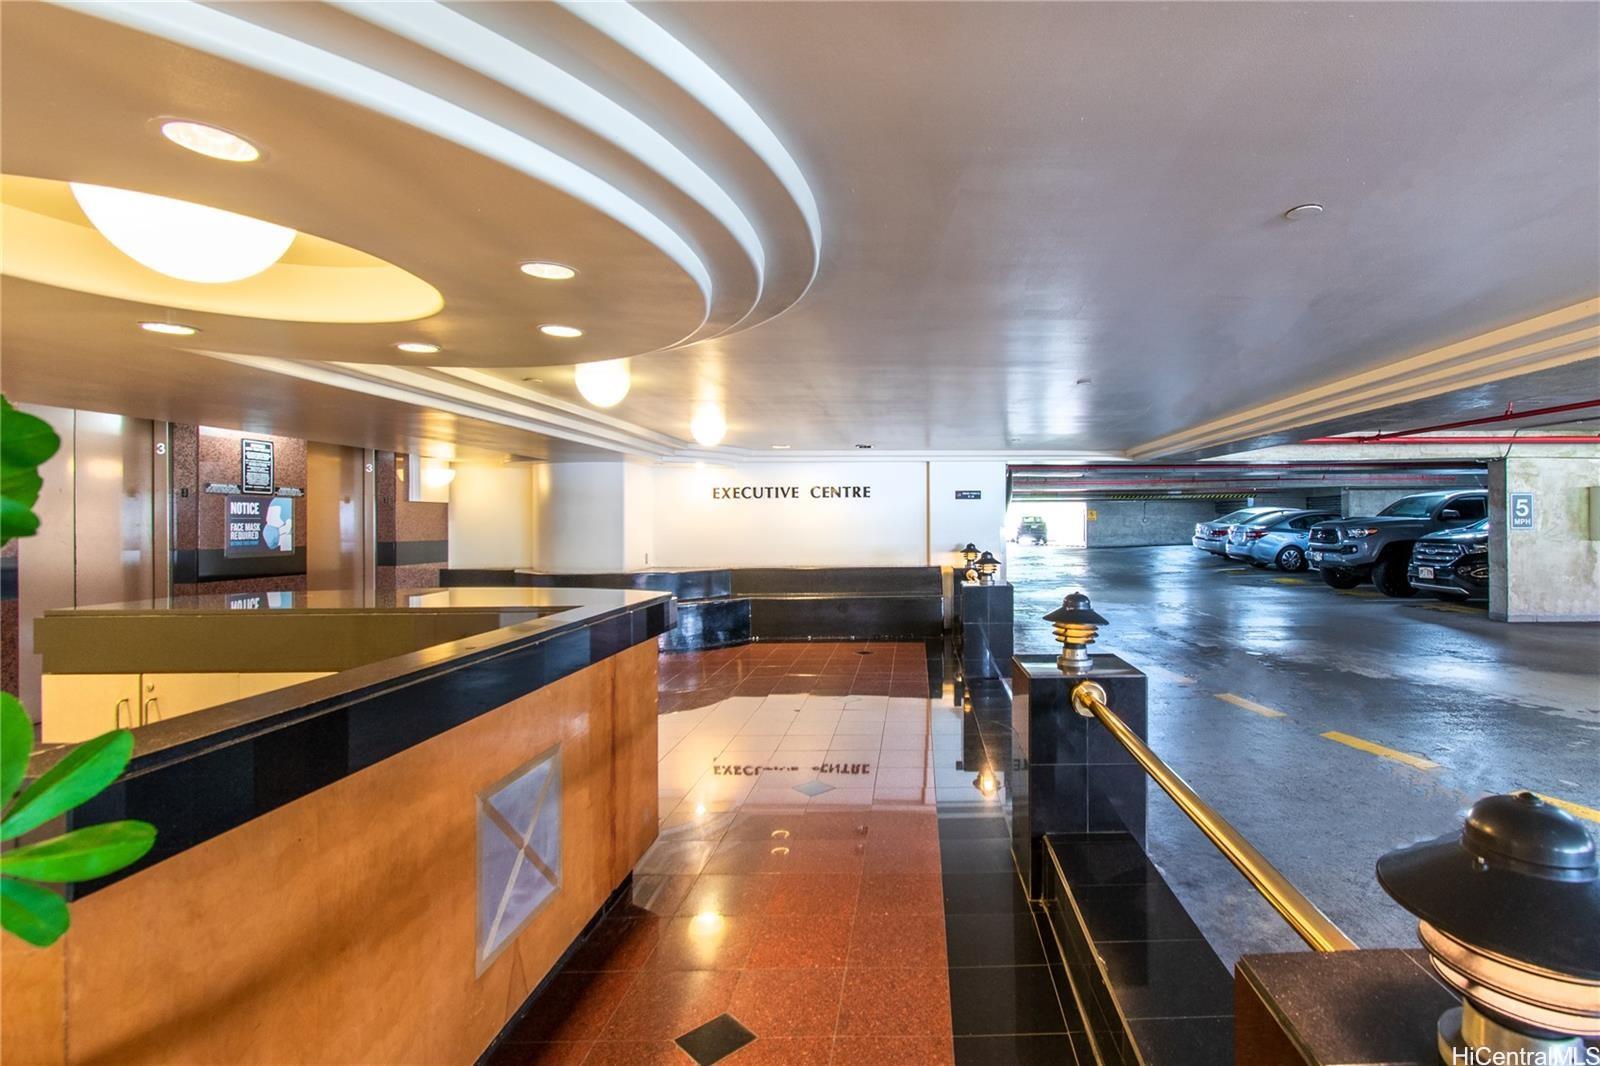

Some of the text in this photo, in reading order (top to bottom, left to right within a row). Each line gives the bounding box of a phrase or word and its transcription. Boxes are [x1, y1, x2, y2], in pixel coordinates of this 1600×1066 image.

[156, 442, 166, 455] 3
[366, 463, 373, 473] 3
[712, 486, 871, 499] EXECUTIVE CENTRE
[230, 502, 260, 515] NOTICE
[1515, 499, 1529, 517] 5
[230, 522, 261, 532] FACE MASK
[230, 531, 259, 540] REQUIRED
